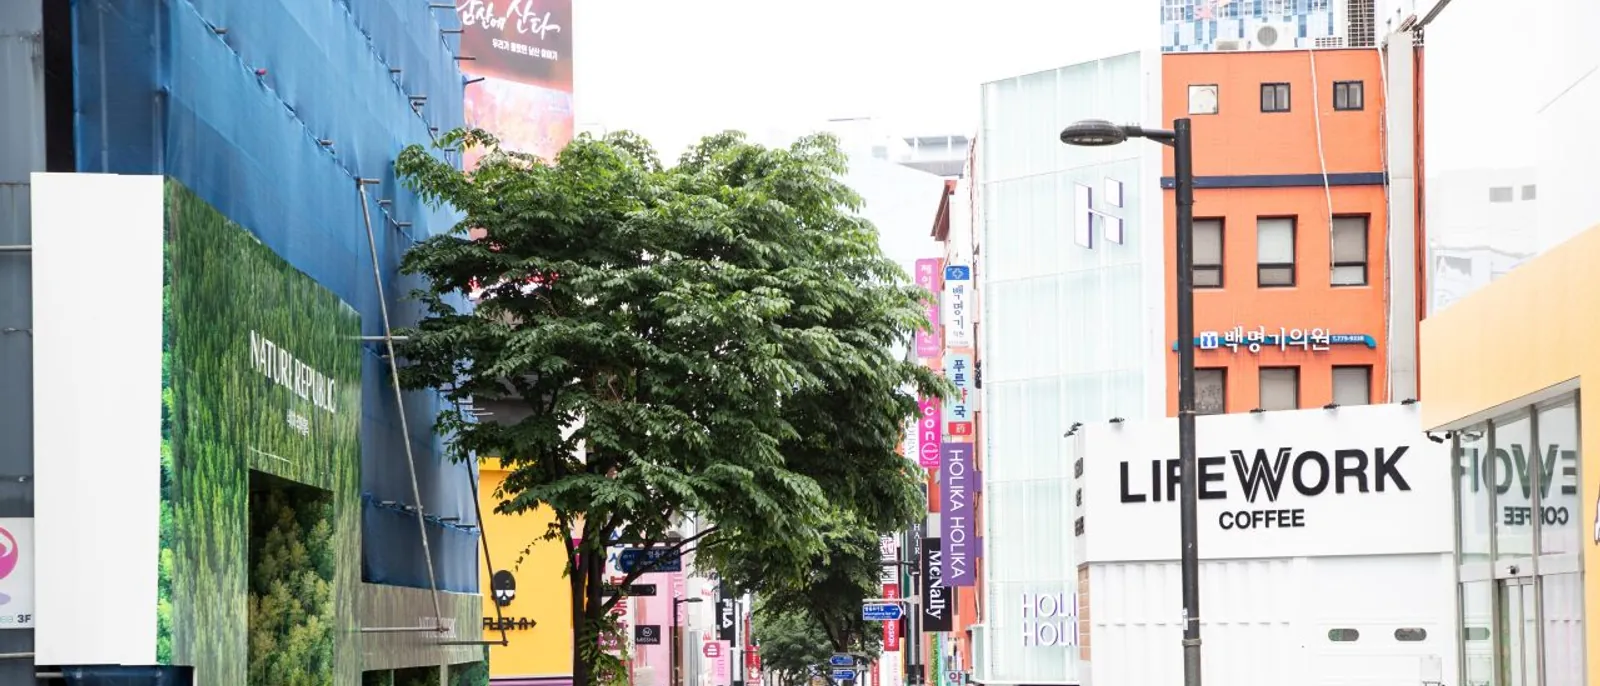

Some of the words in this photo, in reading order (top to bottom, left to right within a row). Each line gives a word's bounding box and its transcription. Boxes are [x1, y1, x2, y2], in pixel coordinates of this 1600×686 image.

[952, 284, 964, 330] 백명기
[1224, 325, 1330, 353] 백명기의원
[294, 358, 336, 413] REPUBLIC
[949, 448, 965, 512] HOLIKA
[1119, 445, 1412, 504] LIFEWORK
[1218, 508, 1306, 531] COFFEE
[950, 516, 966, 579] HOLIKA
[926, 549, 946, 620] McNally
[17, 613, 32, 624] 3F
[722, 598, 734, 629] FILA
[1023, 592, 1077, 618] HOLI
[1023, 620, 1078, 647] HOLI
